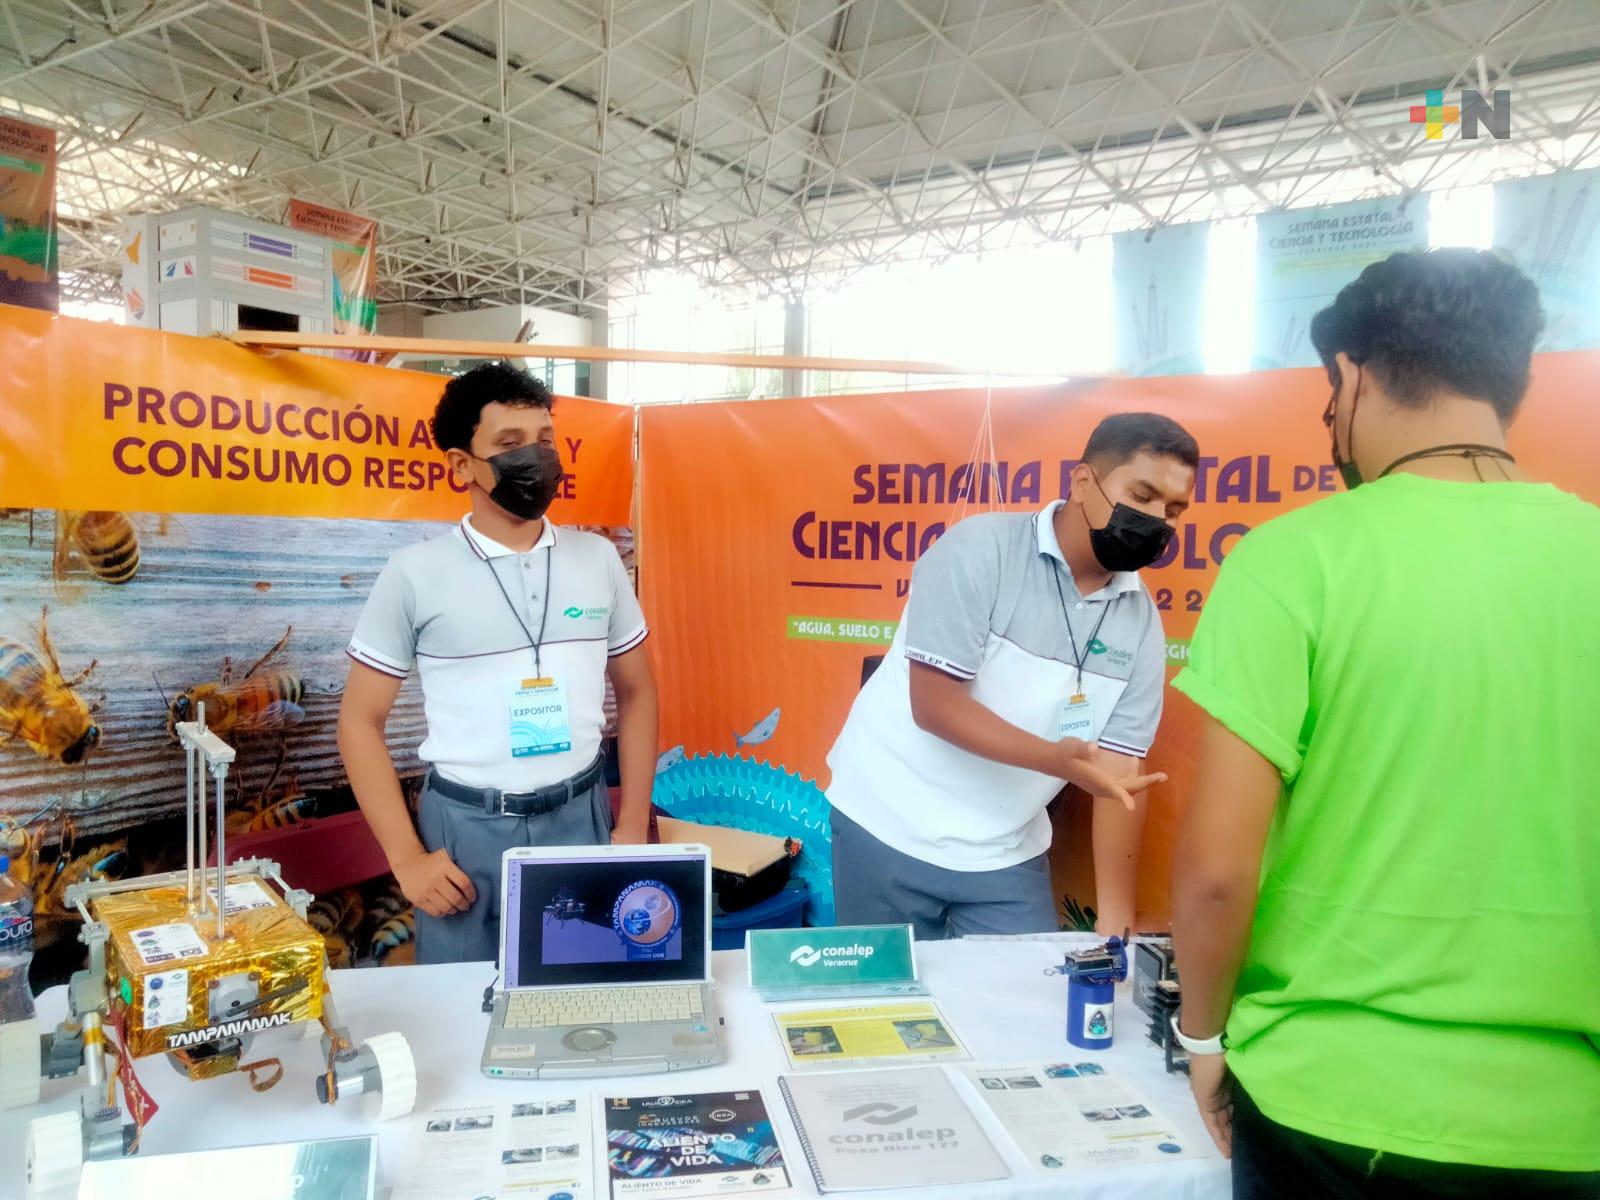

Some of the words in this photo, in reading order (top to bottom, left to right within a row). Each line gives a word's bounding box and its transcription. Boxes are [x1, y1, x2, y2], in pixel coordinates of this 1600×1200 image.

[1288, 219, 1338, 234] SEMANA
[1270, 233, 1314, 249] CIENCIA
[1319, 232, 1326, 244] Y
[104, 382, 399, 447] PRODUCCIÓN
[566, 437, 583, 464] Y
[113, 436, 352, 487] CONSUMO
[853, 461, 1041, 504] SEMANA
[1293, 465, 1337, 492] DE
[839, 623, 880, 639] SUELO
[514, 704, 562, 717] EXPOSITOR
[1061, 719, 1091, 733] EXPOSITOR
[822, 943, 874, 958] conalep
[823, 959, 858, 967] Veracruz
[168, 1012, 293, 1049] TAMPANAMAK
[650, 1132, 737, 1148] ALIENTO
[828, 1127, 956, 1146] conalep
[680, 1145, 707, 1156] DE
[670, 1155, 723, 1167] VIDA
[621, 1181, 663, 1189] ALIENTO
